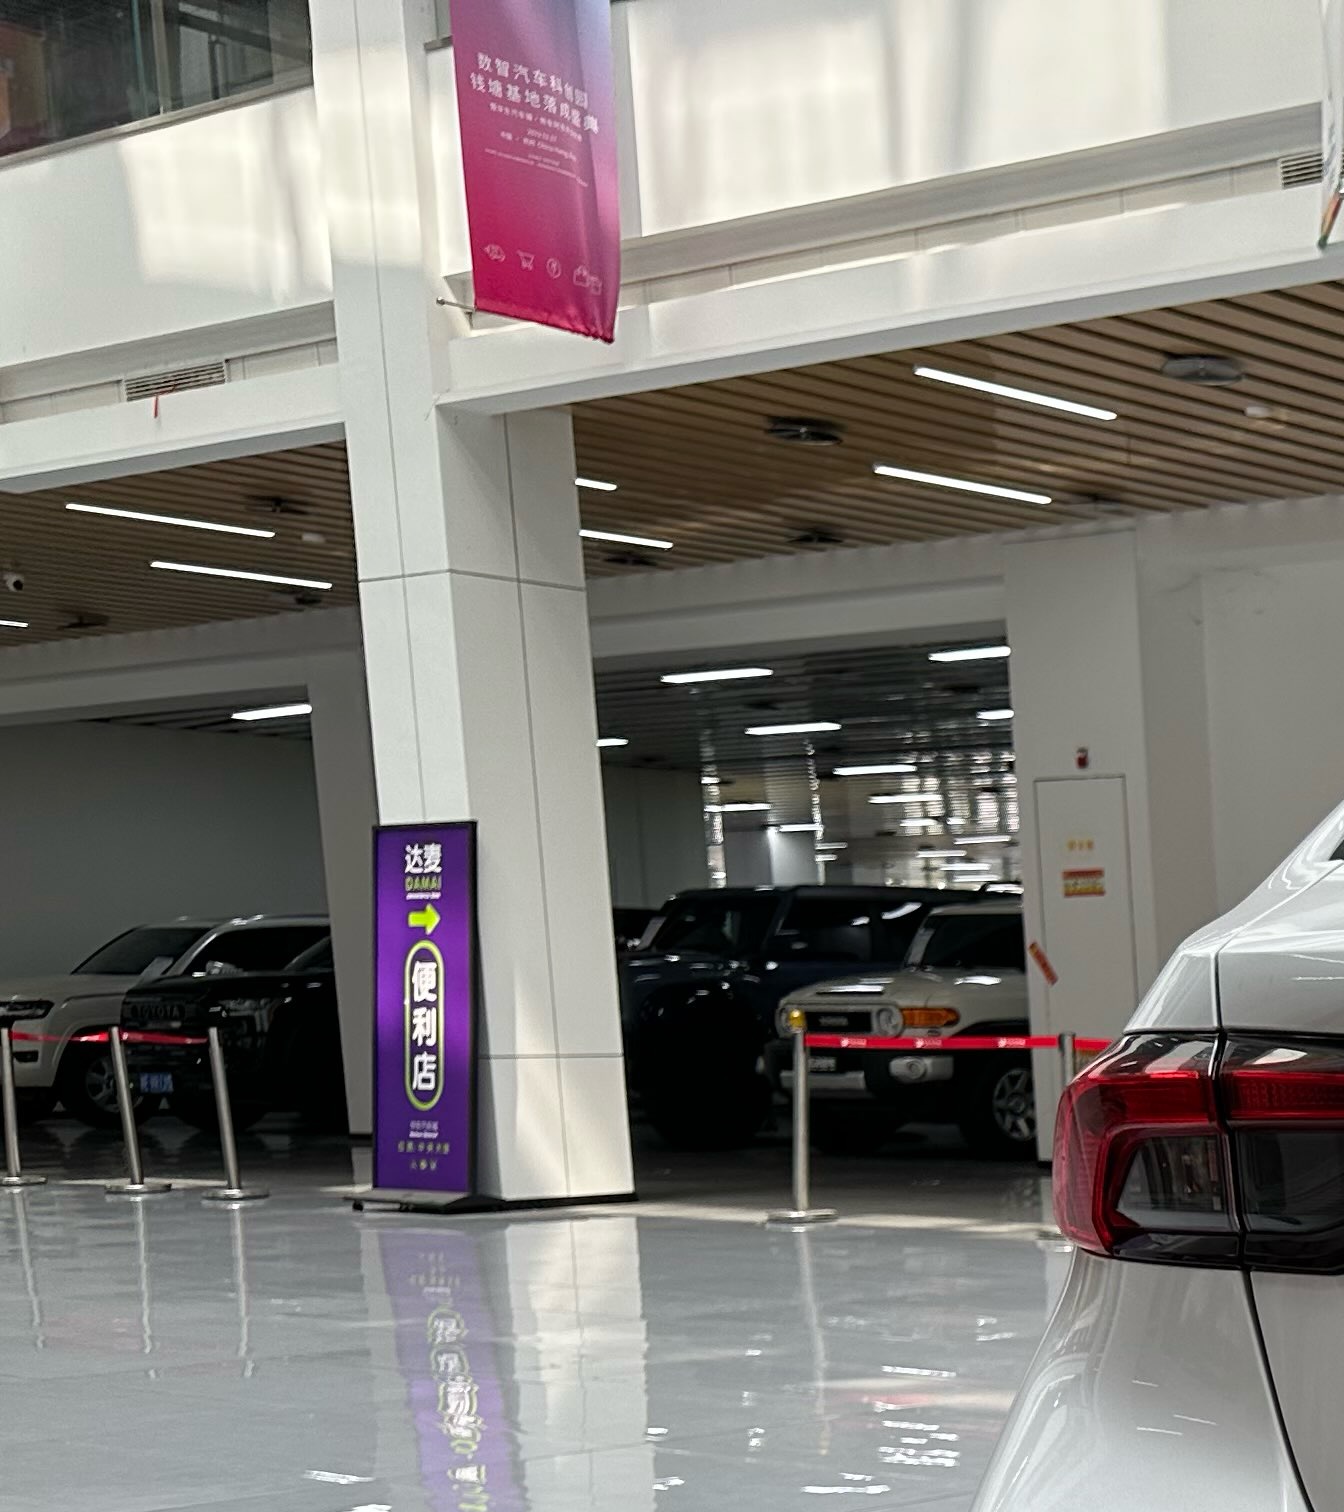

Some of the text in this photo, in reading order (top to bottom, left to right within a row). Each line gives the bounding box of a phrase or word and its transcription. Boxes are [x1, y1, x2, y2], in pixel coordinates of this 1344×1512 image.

[405, 843, 442, 874] 达麦
[411, 960, 438, 1091] 便利店
